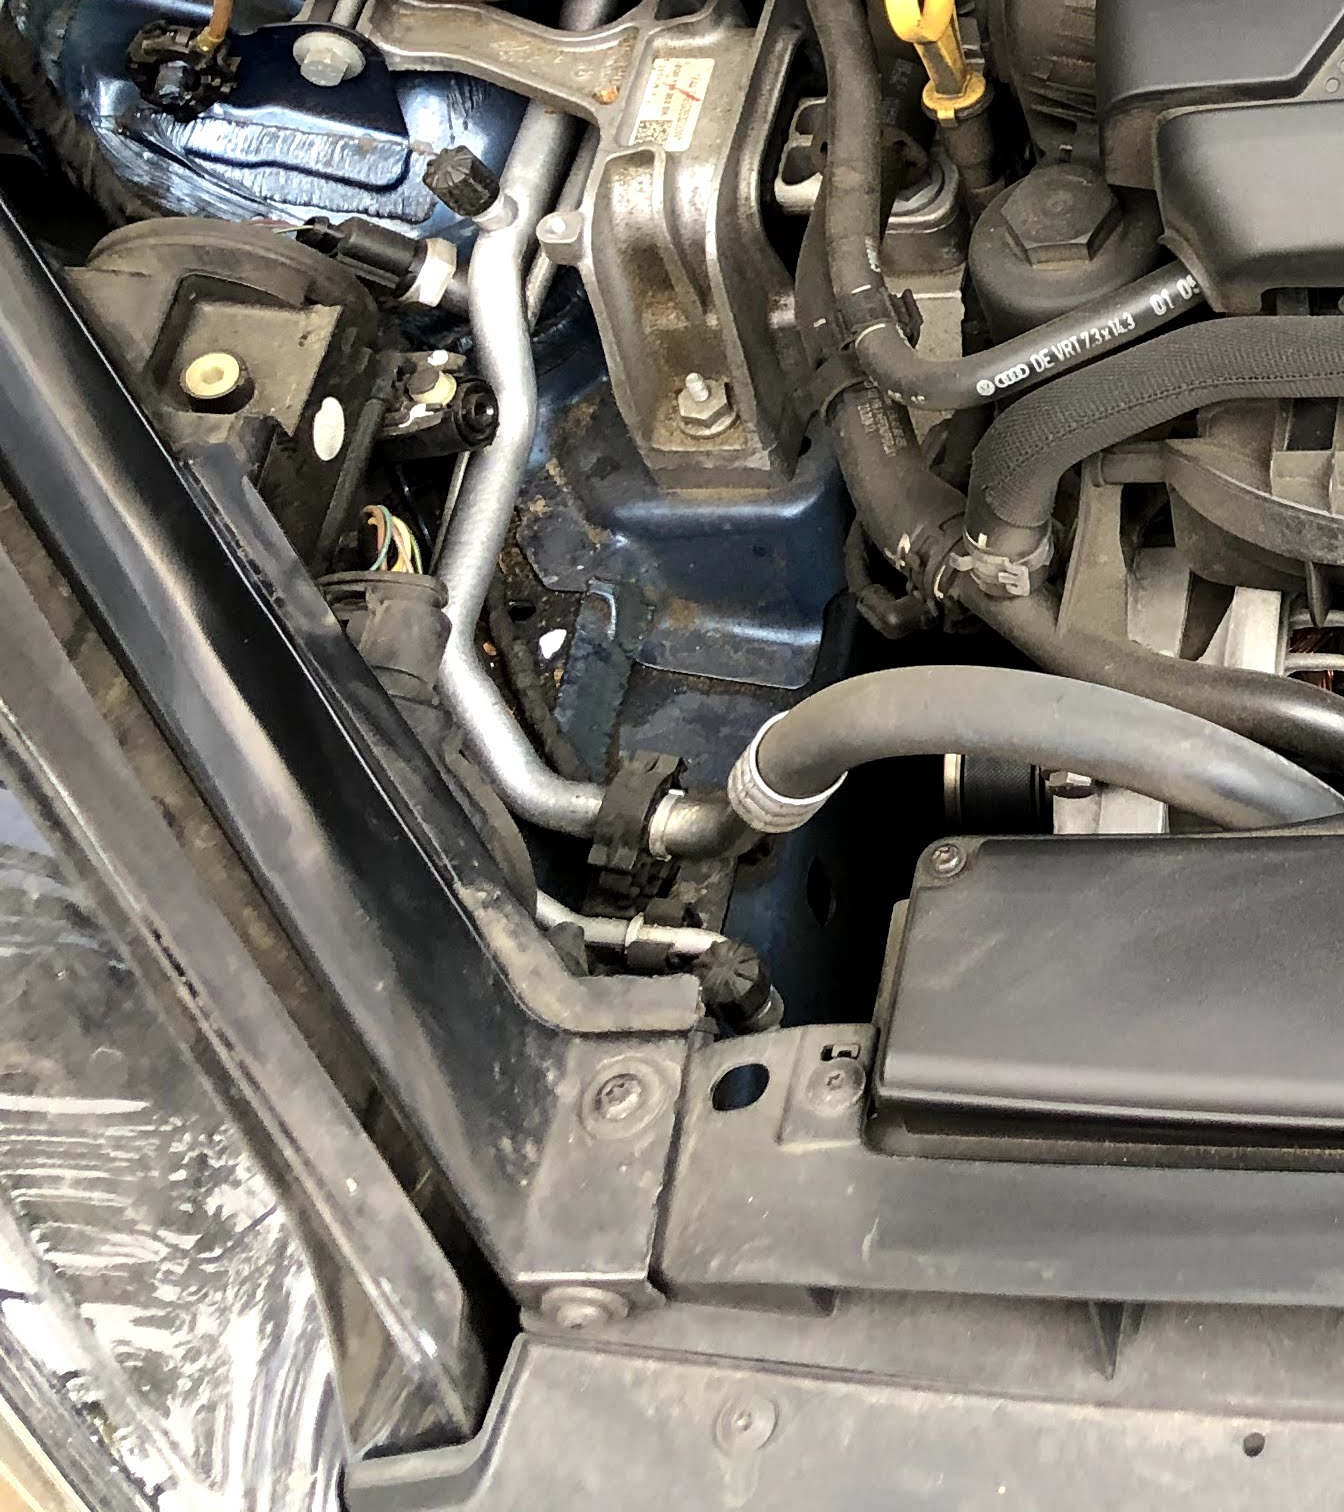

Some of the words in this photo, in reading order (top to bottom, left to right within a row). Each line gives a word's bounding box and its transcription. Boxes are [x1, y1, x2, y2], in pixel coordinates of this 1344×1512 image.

[1030, 348, 1055, 373] DE
[1054, 335, 1082, 361] VRT
[1150, 289, 1175, 316] 01
